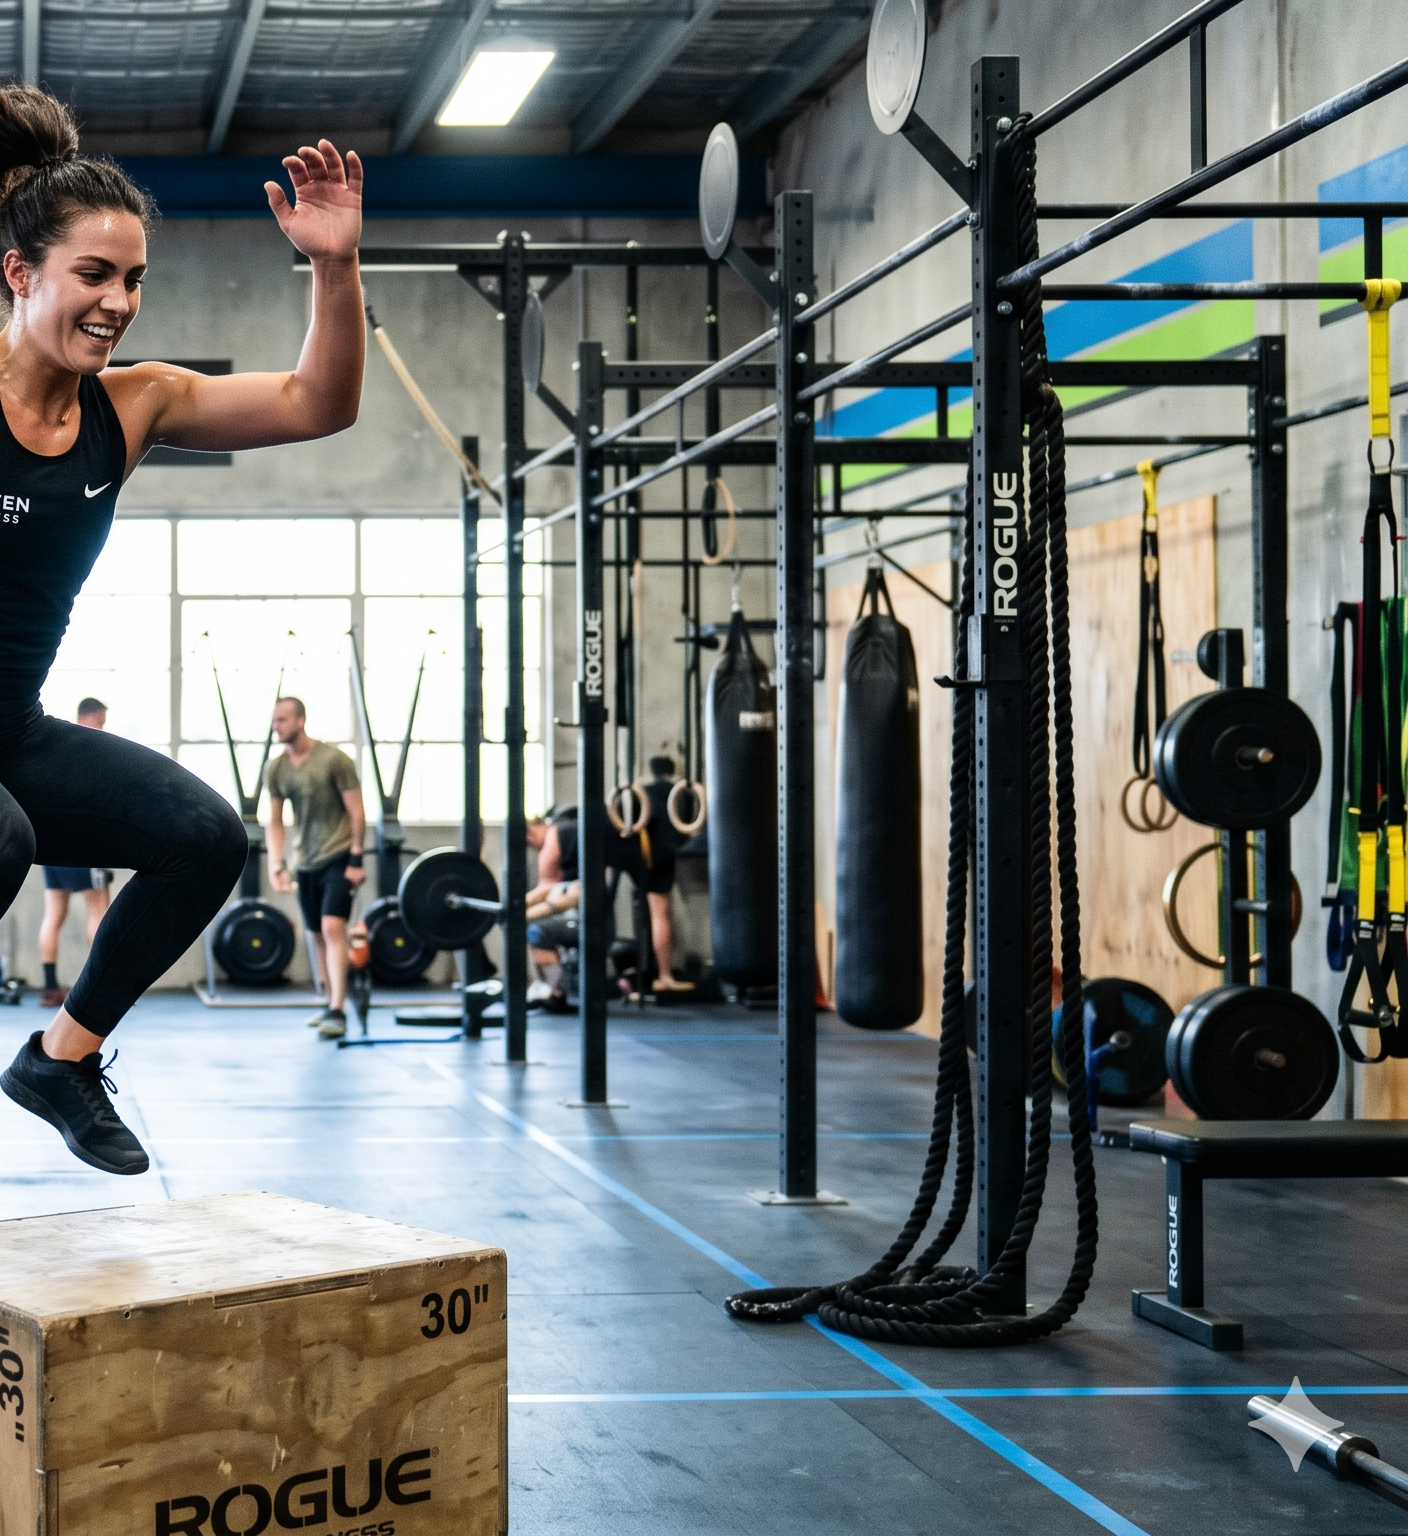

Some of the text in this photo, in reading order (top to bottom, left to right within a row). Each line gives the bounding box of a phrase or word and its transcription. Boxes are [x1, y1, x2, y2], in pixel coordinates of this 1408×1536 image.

[993, 472, 1018, 617] ROGUE
[585, 609, 602, 697] ROGUE
[1168, 1194, 1178, 1289] ROGUE
[421, 1284, 489, 1339] 30"
